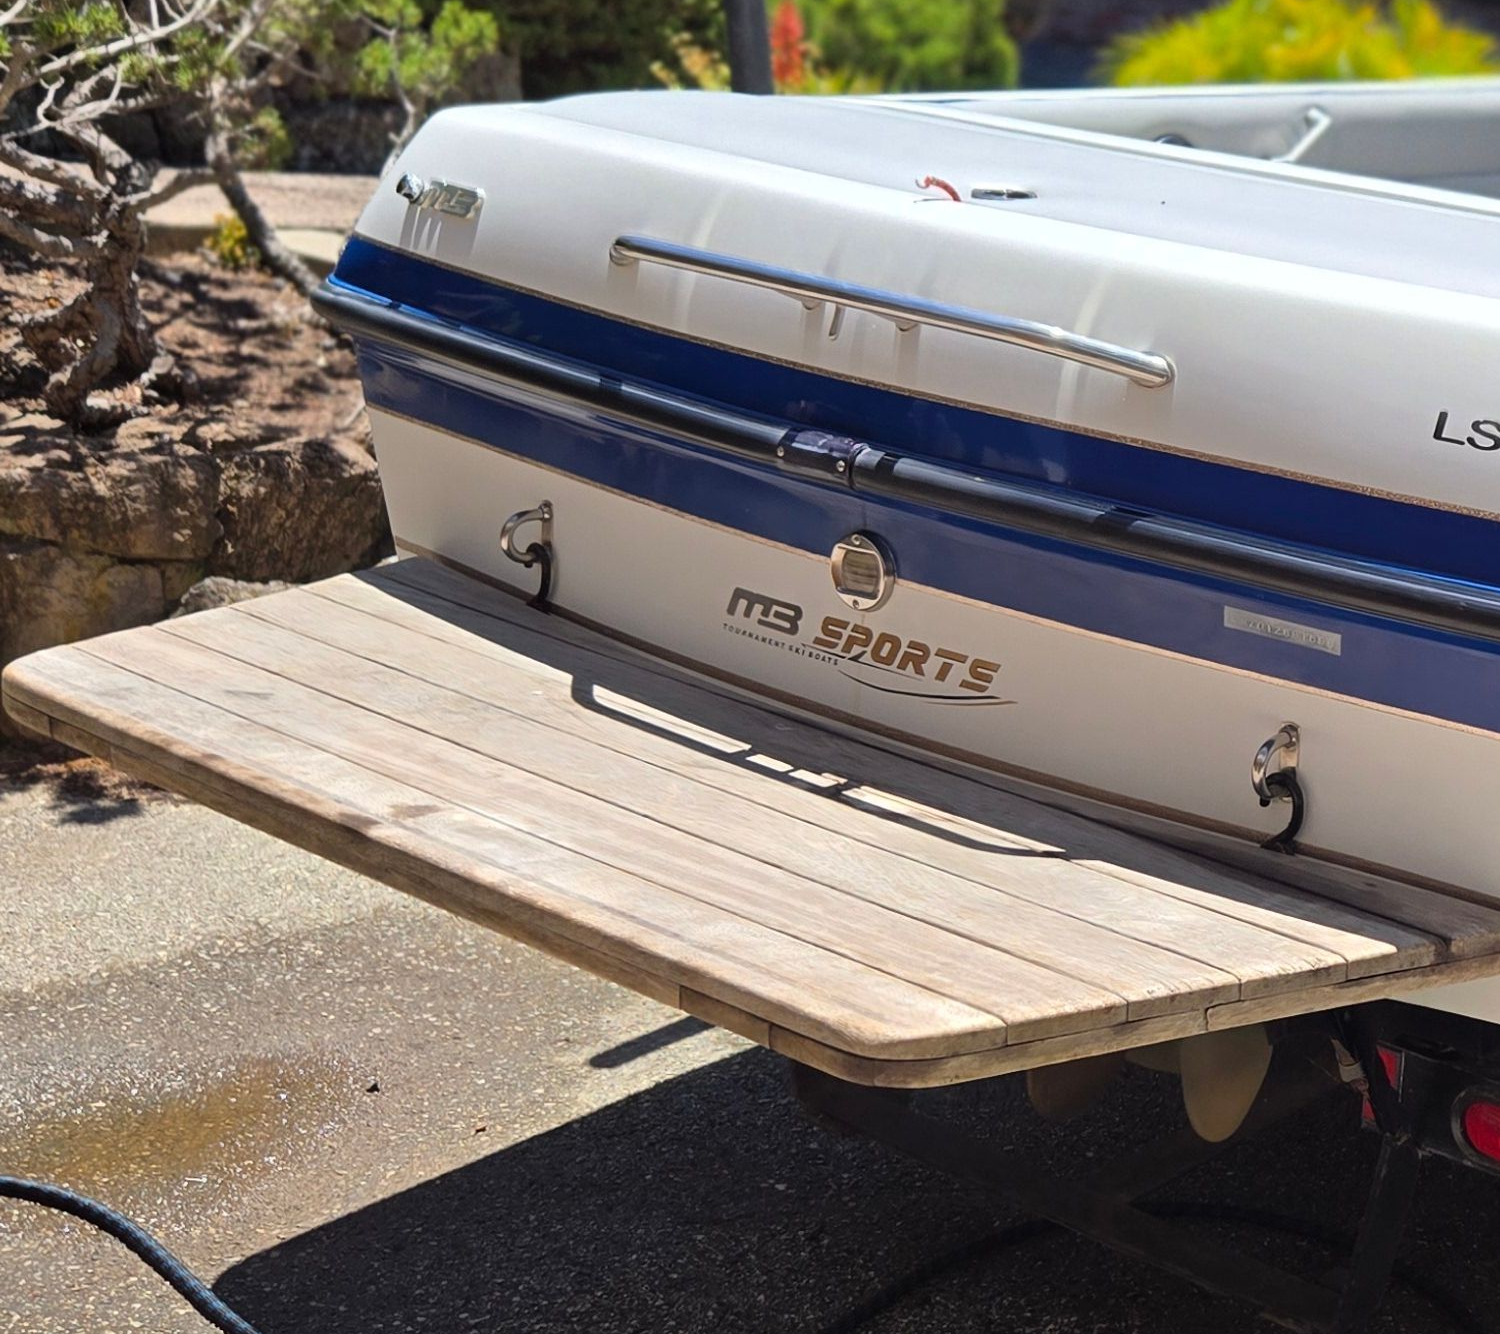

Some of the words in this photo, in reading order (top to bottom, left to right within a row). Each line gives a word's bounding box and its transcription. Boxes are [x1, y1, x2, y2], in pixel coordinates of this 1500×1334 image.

[723, 622, 786, 648] TOURNAMENT
[788, 644, 806, 657] SKI
[808, 650, 839, 666] BOATS
[726, 586, 803, 636] MB
[813, 615, 1002, 693] SPORTS
